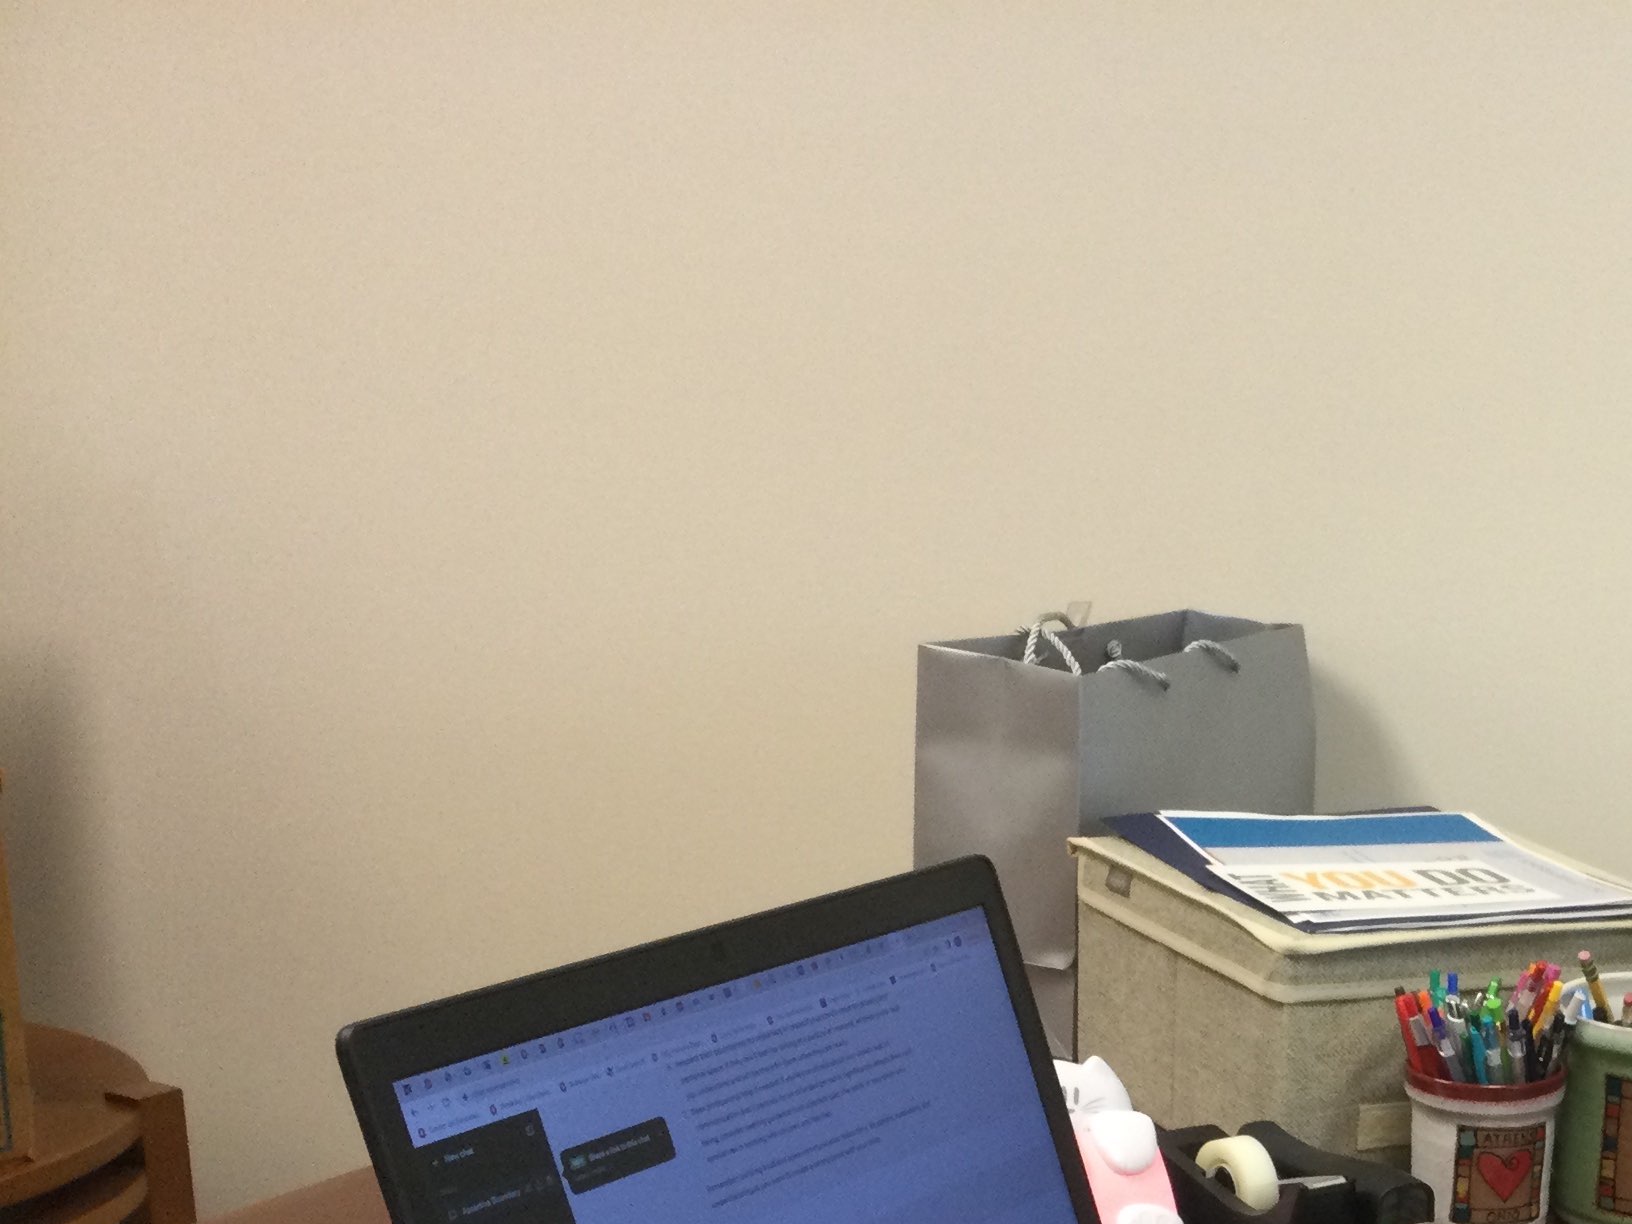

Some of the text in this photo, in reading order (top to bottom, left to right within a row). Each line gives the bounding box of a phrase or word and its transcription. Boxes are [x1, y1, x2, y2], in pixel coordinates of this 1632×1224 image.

[1280, 867, 1511, 890] YOU DO
[1312, 884, 1535, 901] MATTERS
